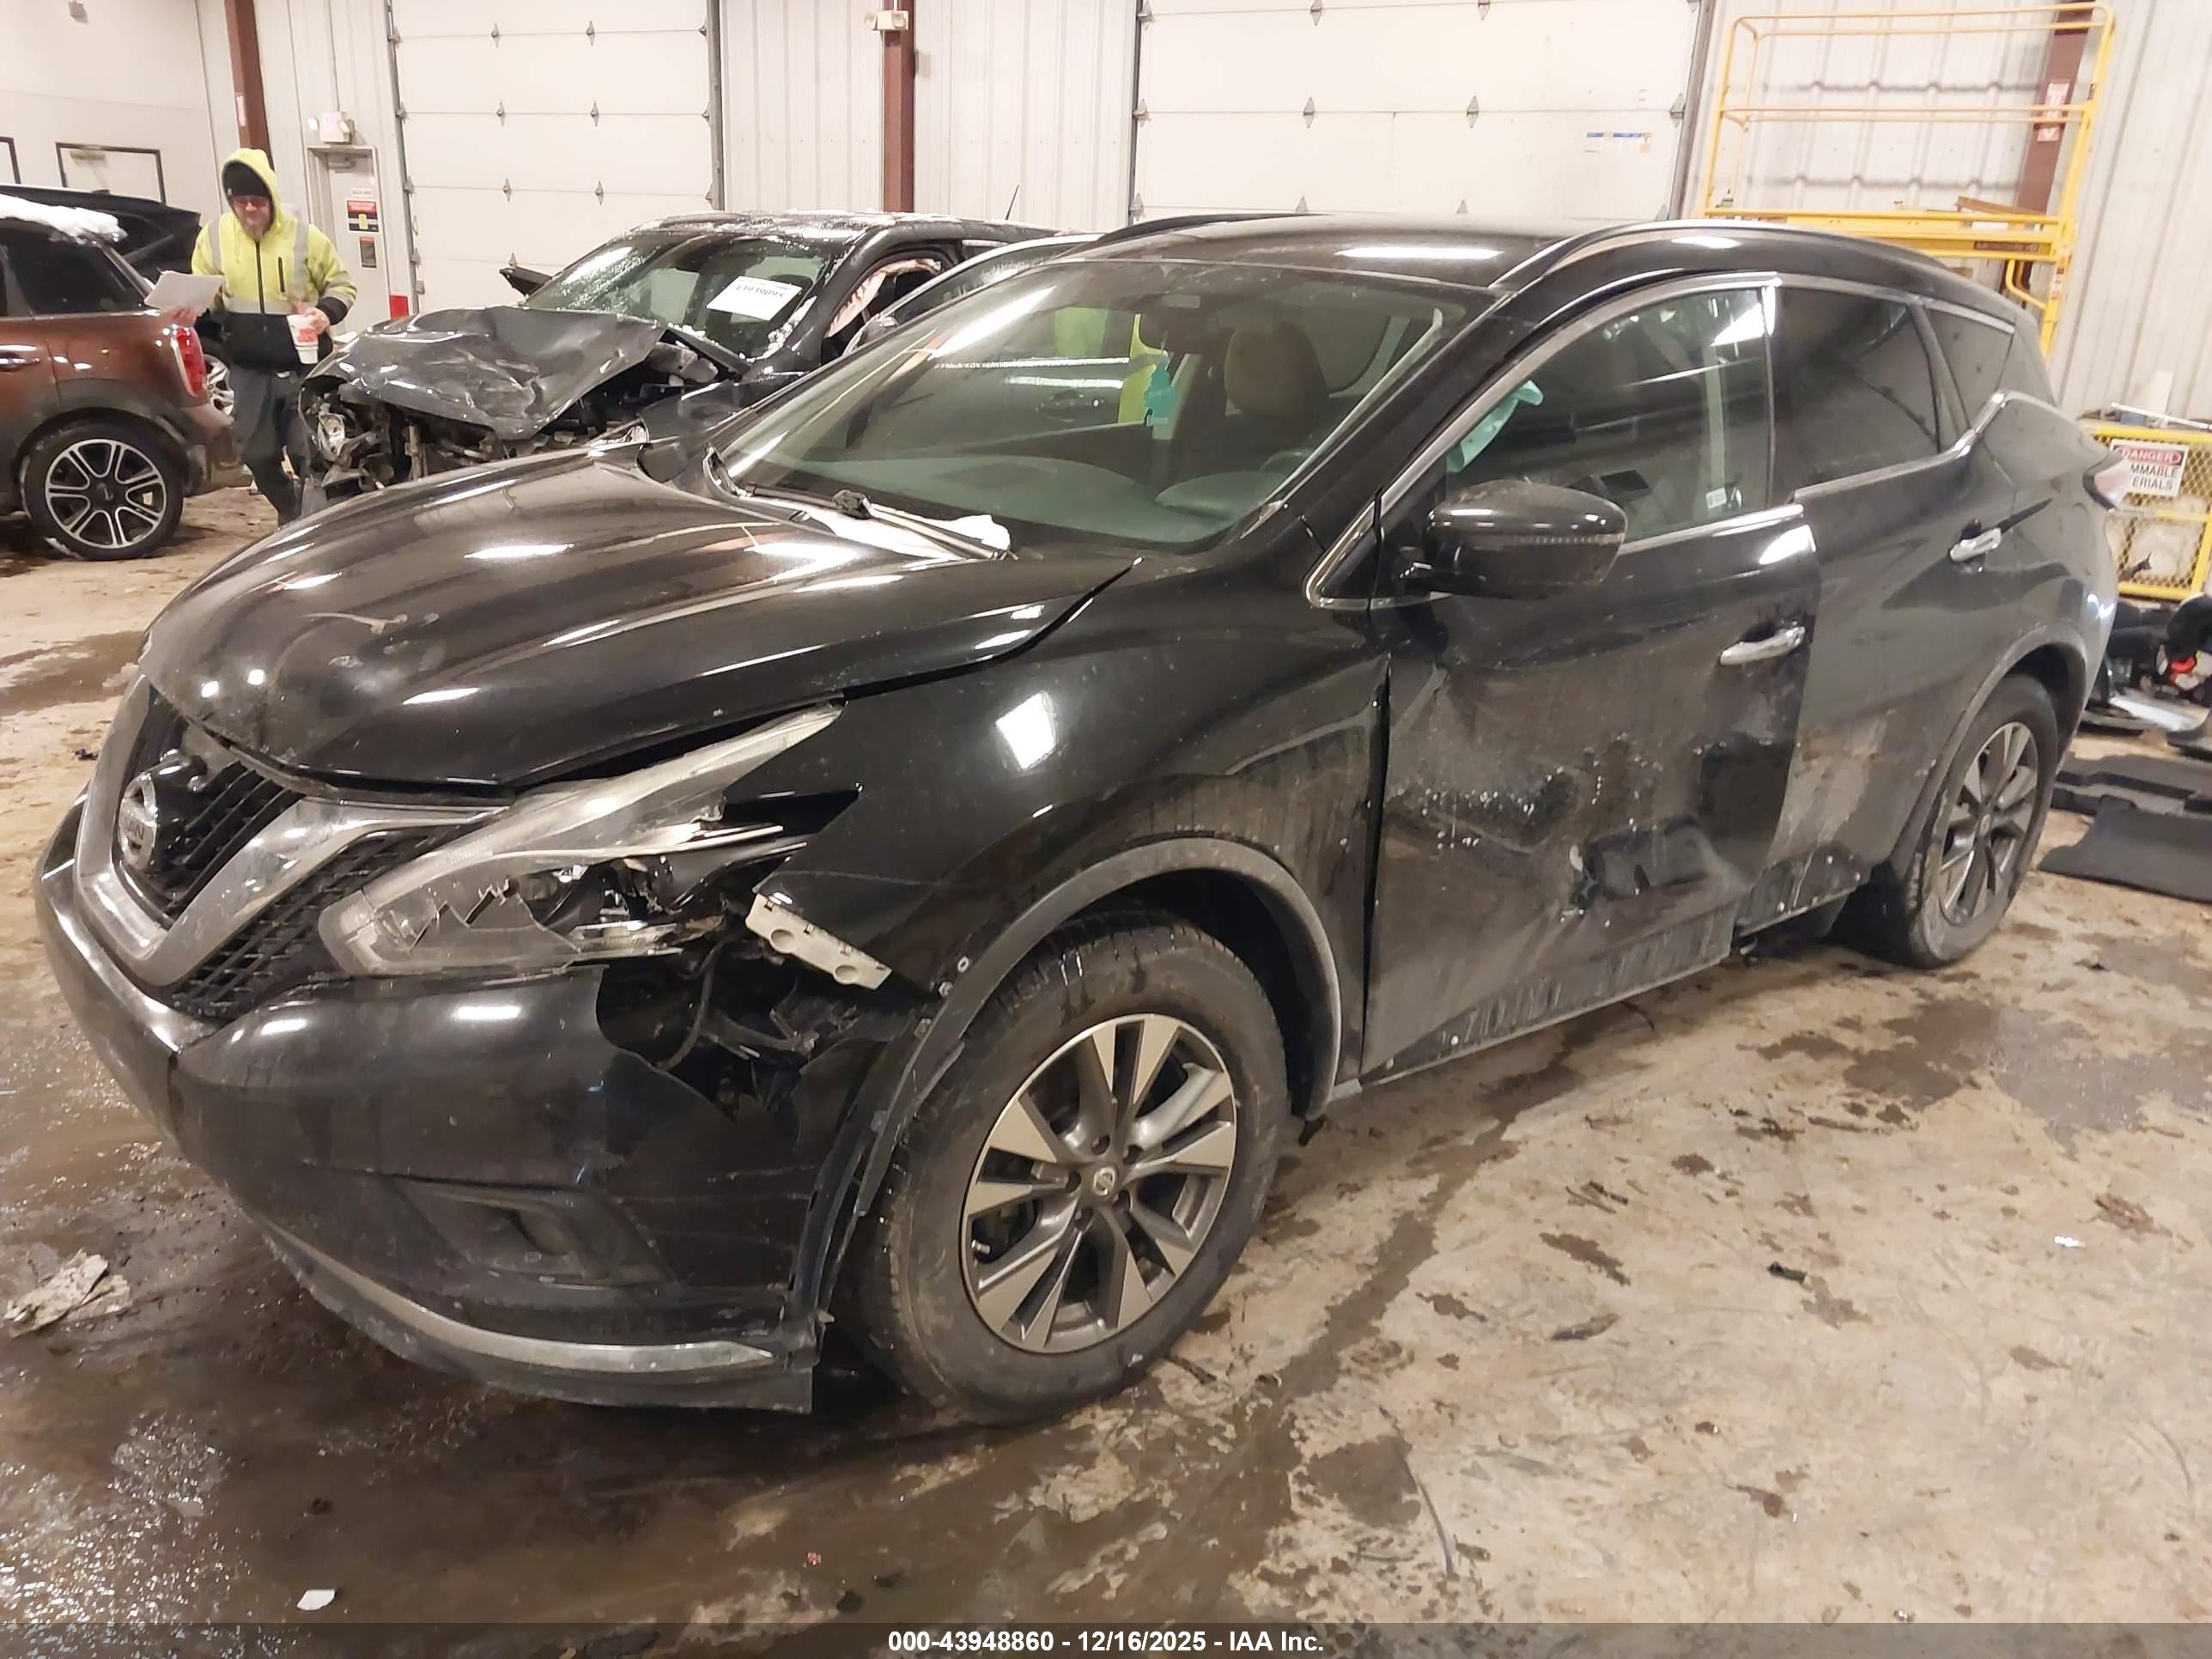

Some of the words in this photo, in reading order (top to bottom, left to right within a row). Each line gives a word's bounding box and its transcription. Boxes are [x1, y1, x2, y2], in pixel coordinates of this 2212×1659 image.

[2122, 447, 2172, 463] DANGER
[2130, 464, 2179, 477] MMABLE
[2132, 477, 2172, 490] ERIALS
